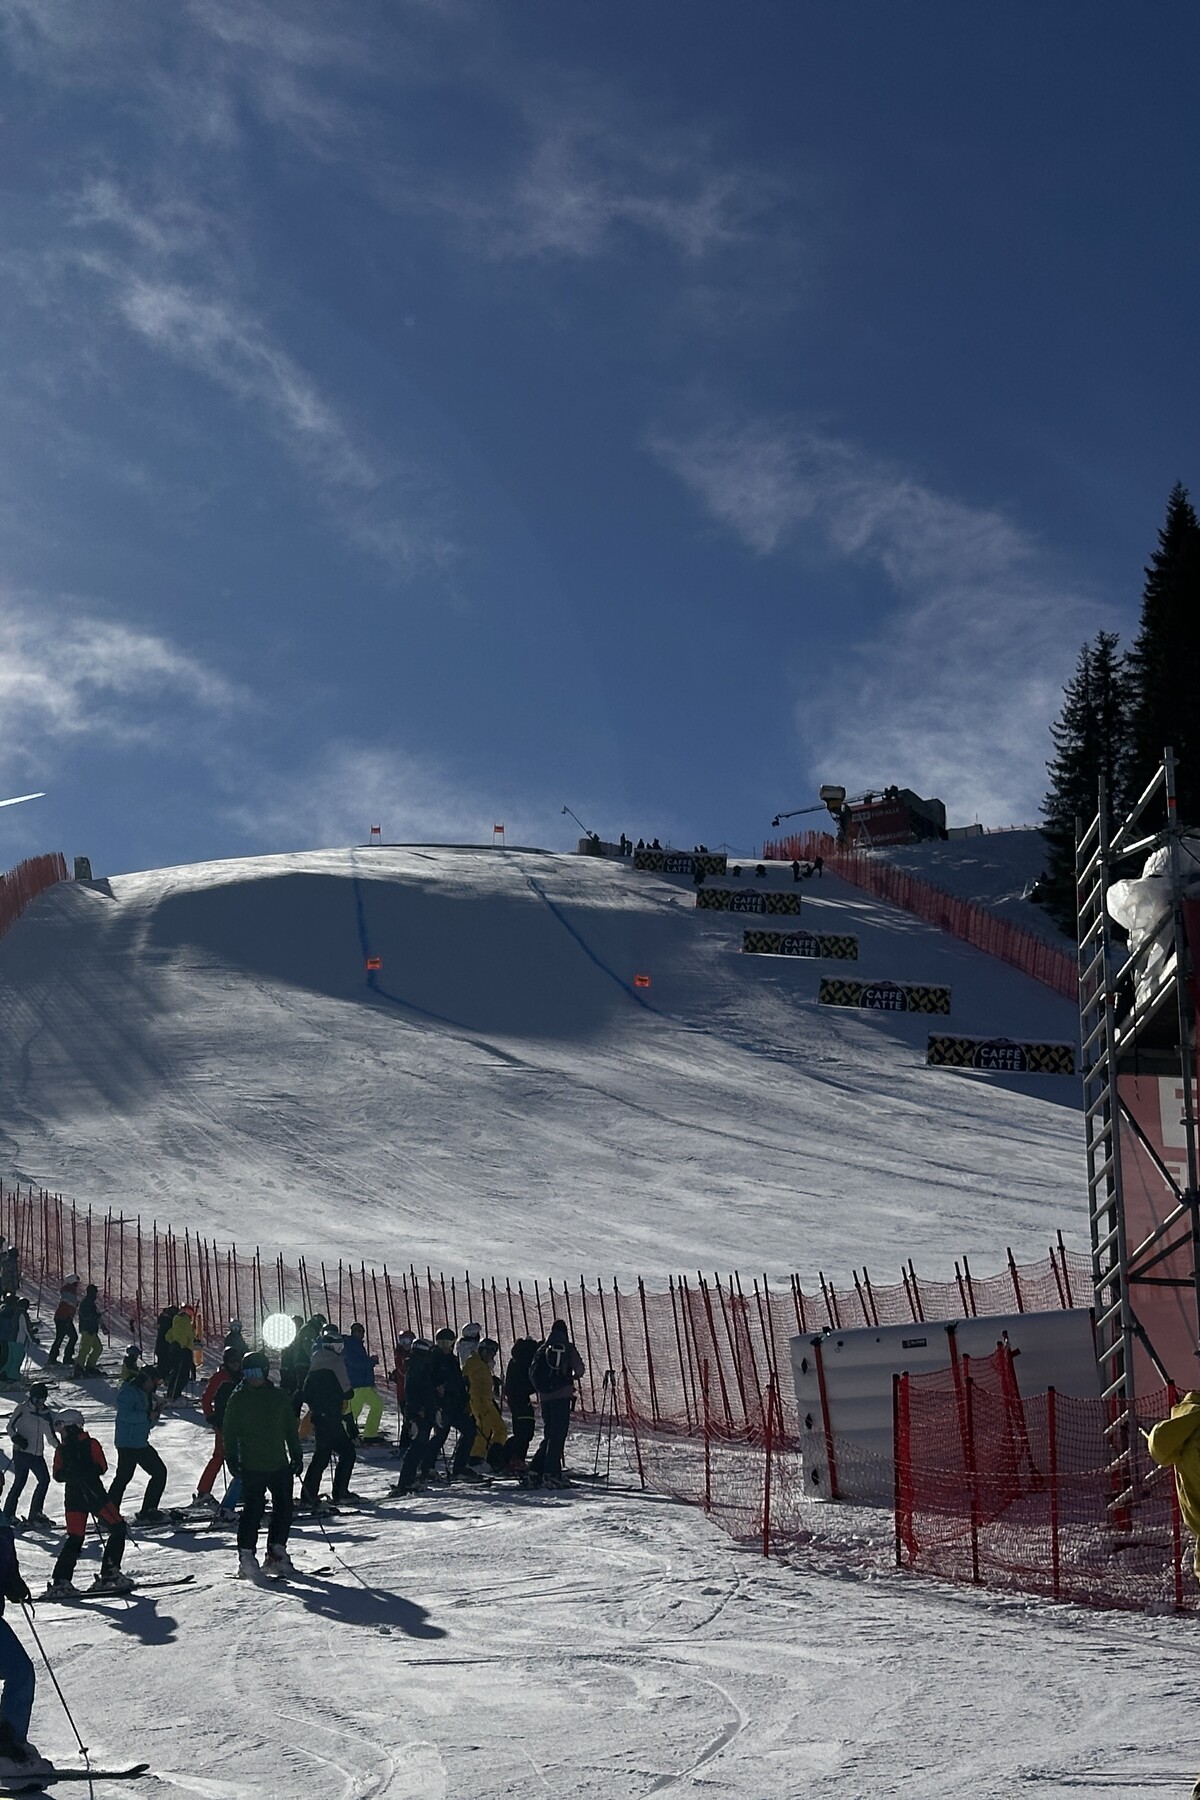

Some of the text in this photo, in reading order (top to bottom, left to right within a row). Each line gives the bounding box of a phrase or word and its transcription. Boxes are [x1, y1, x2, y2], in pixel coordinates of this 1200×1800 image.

[733, 904, 762, 913] LATTE
[784, 948, 816, 957] LATTE
[866, 989, 903, 1001] CAFFÈ
[866, 999, 902, 1010] LATTE
[980, 1048, 1021, 1060] CAFFÈ
[980, 1059, 1021, 1071] LATTE
